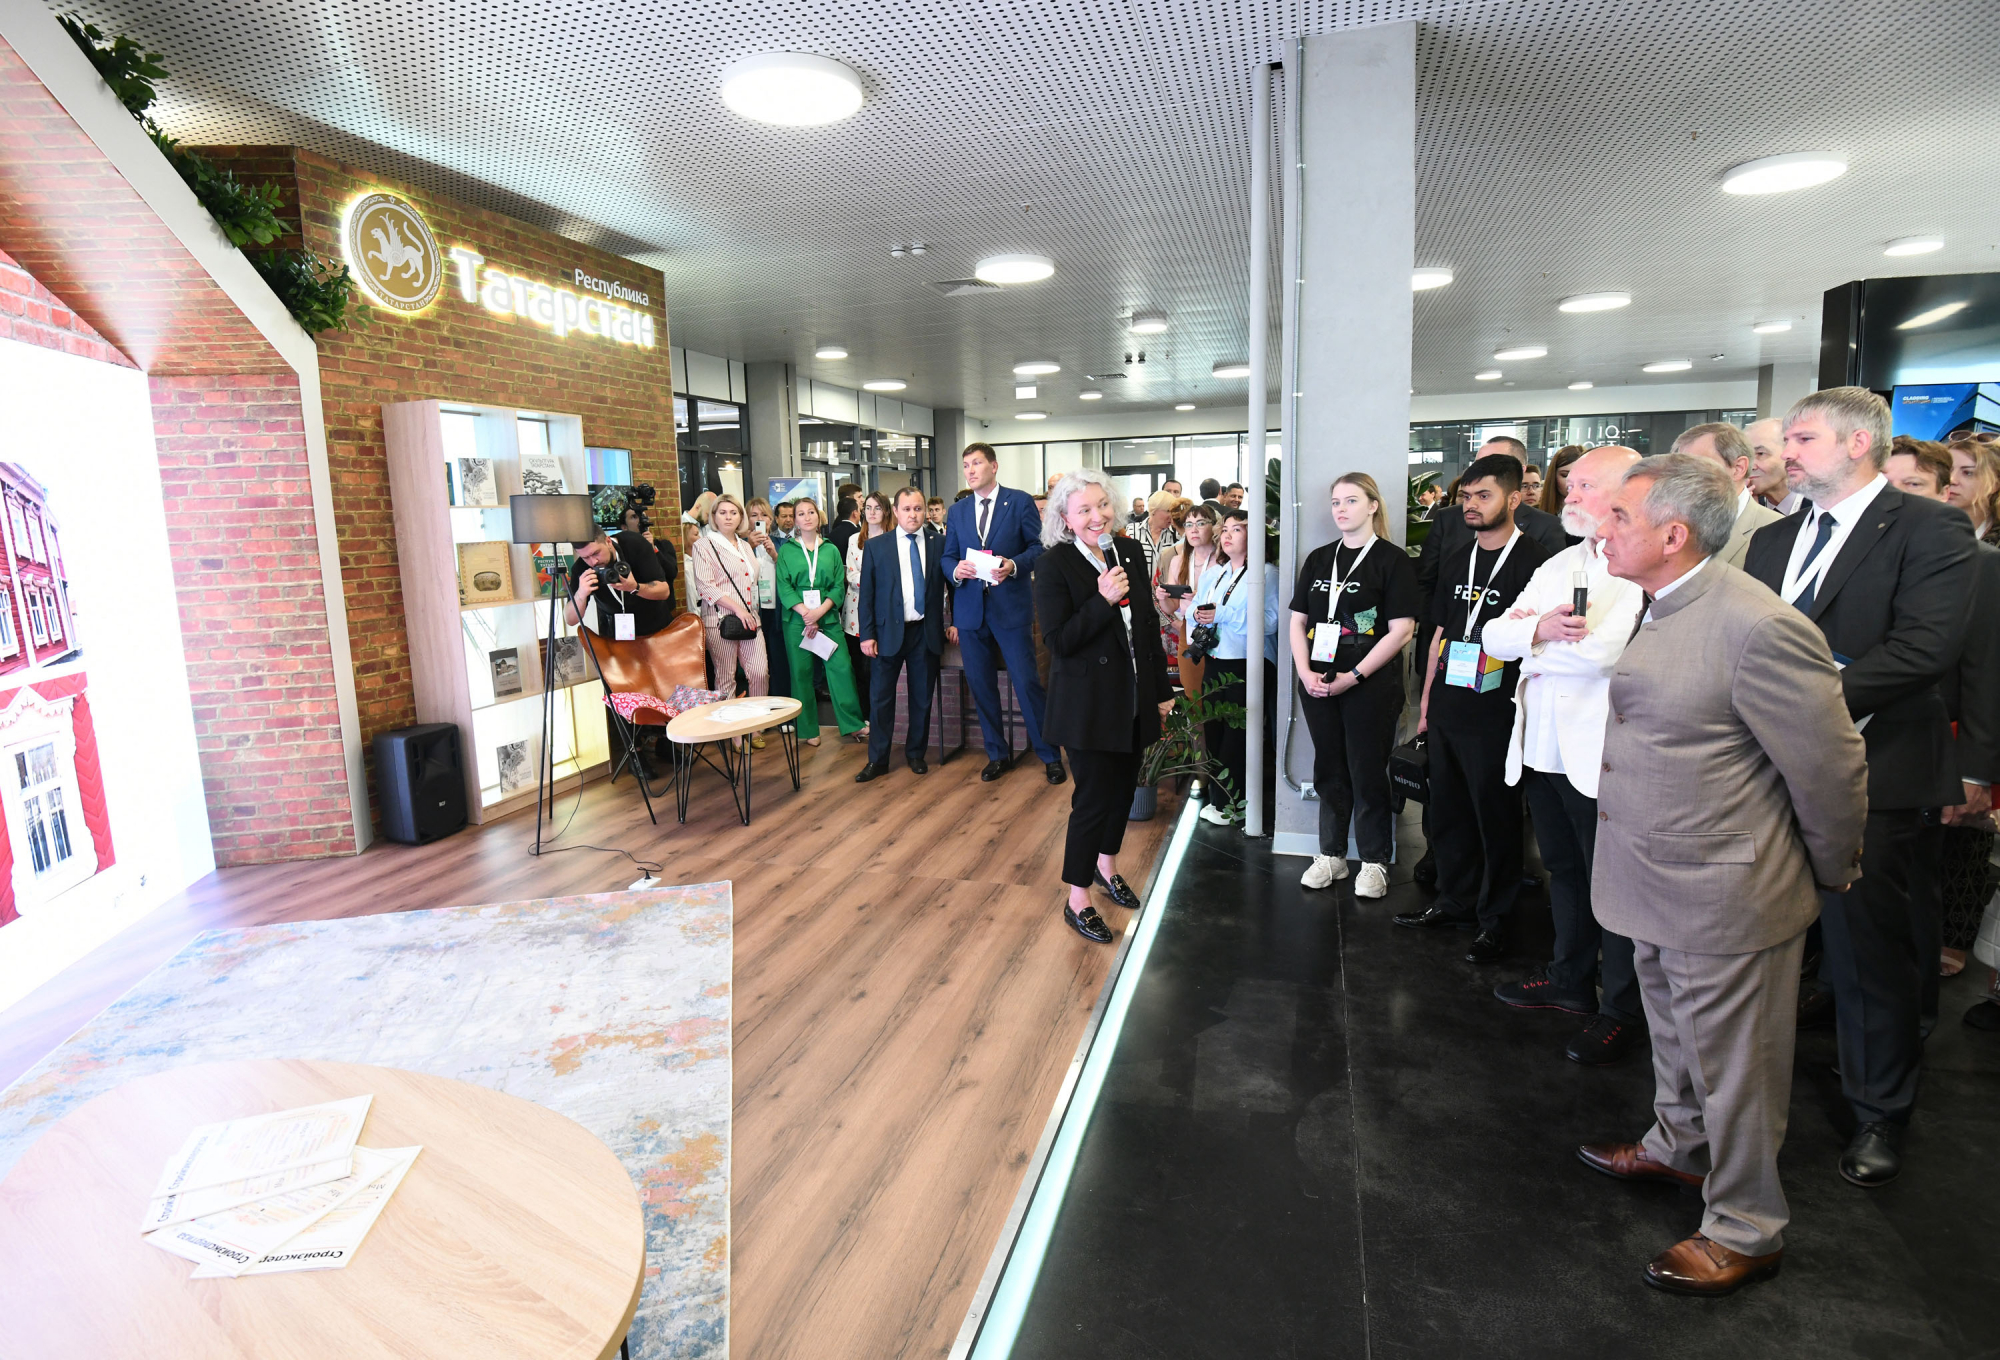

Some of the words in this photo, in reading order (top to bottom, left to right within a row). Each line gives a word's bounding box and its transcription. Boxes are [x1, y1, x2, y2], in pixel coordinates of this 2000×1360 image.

[379, 291, 425, 310] ТАТАРСТАН
[451, 248, 656, 347] Татарстан
[574, 268, 649, 306] Республика
